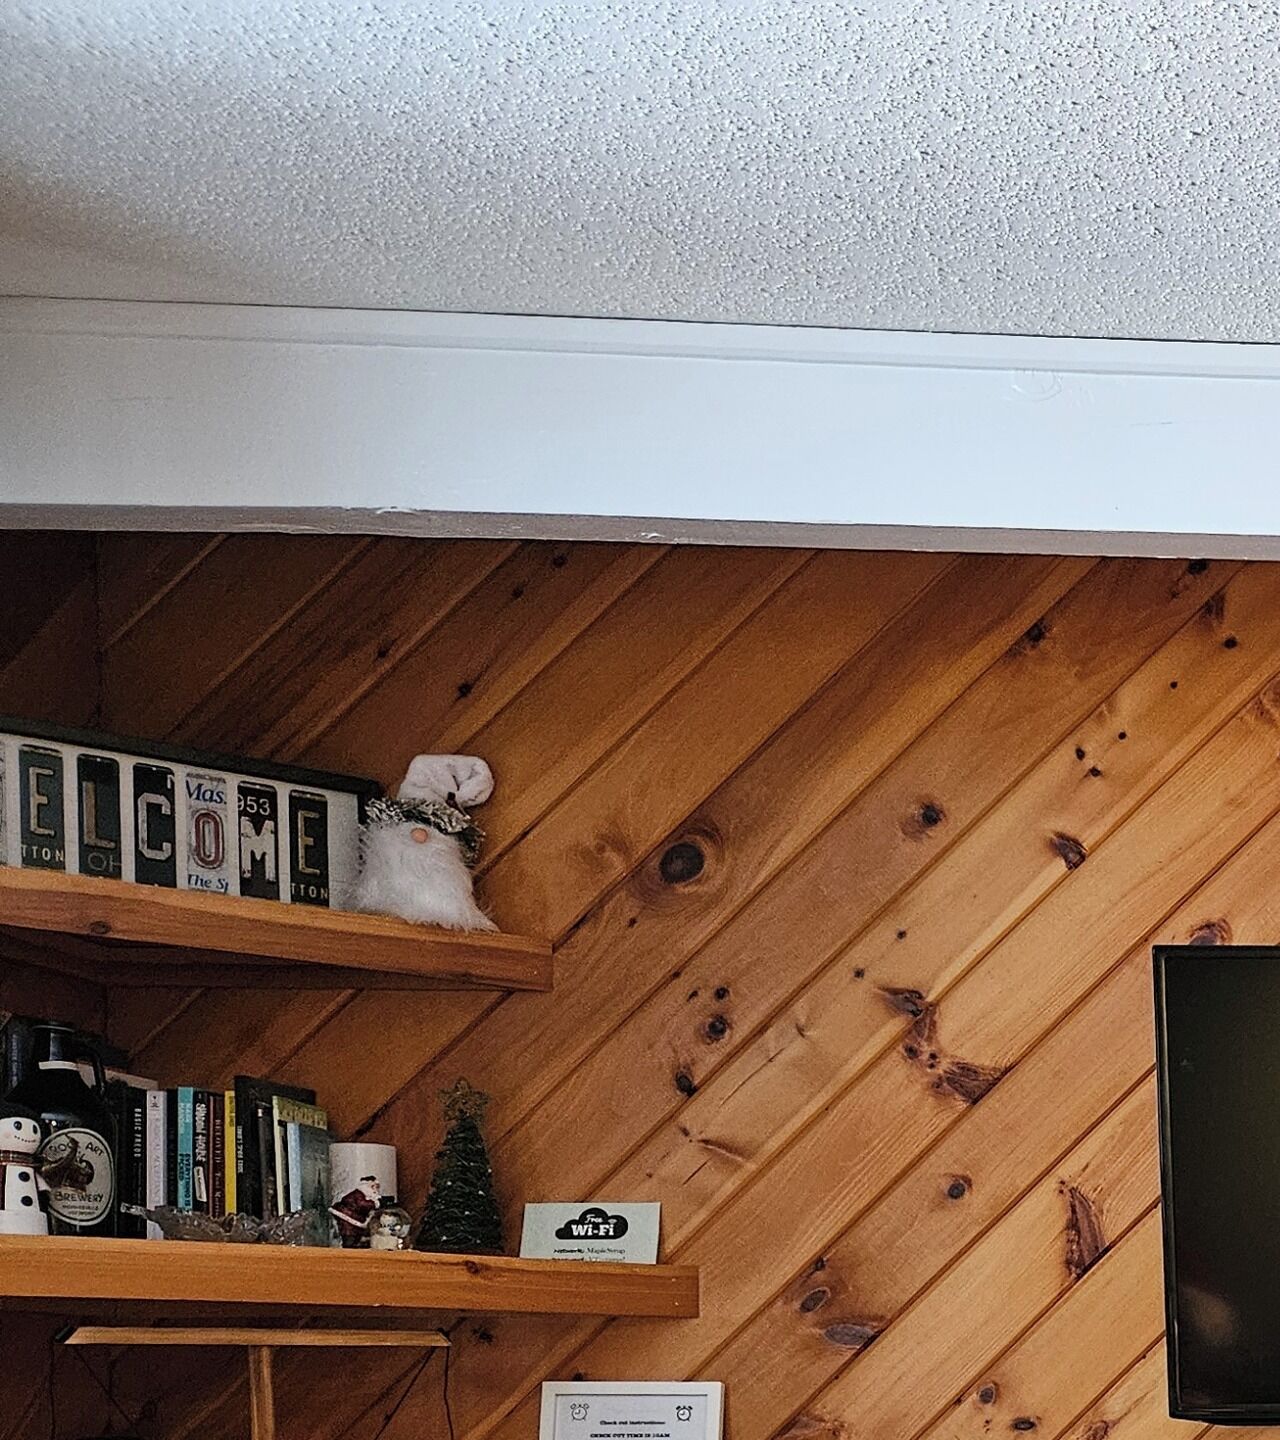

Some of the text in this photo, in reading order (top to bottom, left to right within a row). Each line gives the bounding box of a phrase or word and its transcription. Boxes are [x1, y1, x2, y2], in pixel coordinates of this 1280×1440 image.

[0, 765, 322, 878] ELCOME
[133, 1108, 142, 1131] BASIC
[133, 1133, 142, 1158] FREUD
[195, 1134, 207, 1162] HOUSE
[214, 1119, 222, 1163] BELOVED
[55, 1191, 104, 1203] BREWERY
[570, 1224, 615, 1237] Wi-Fi
